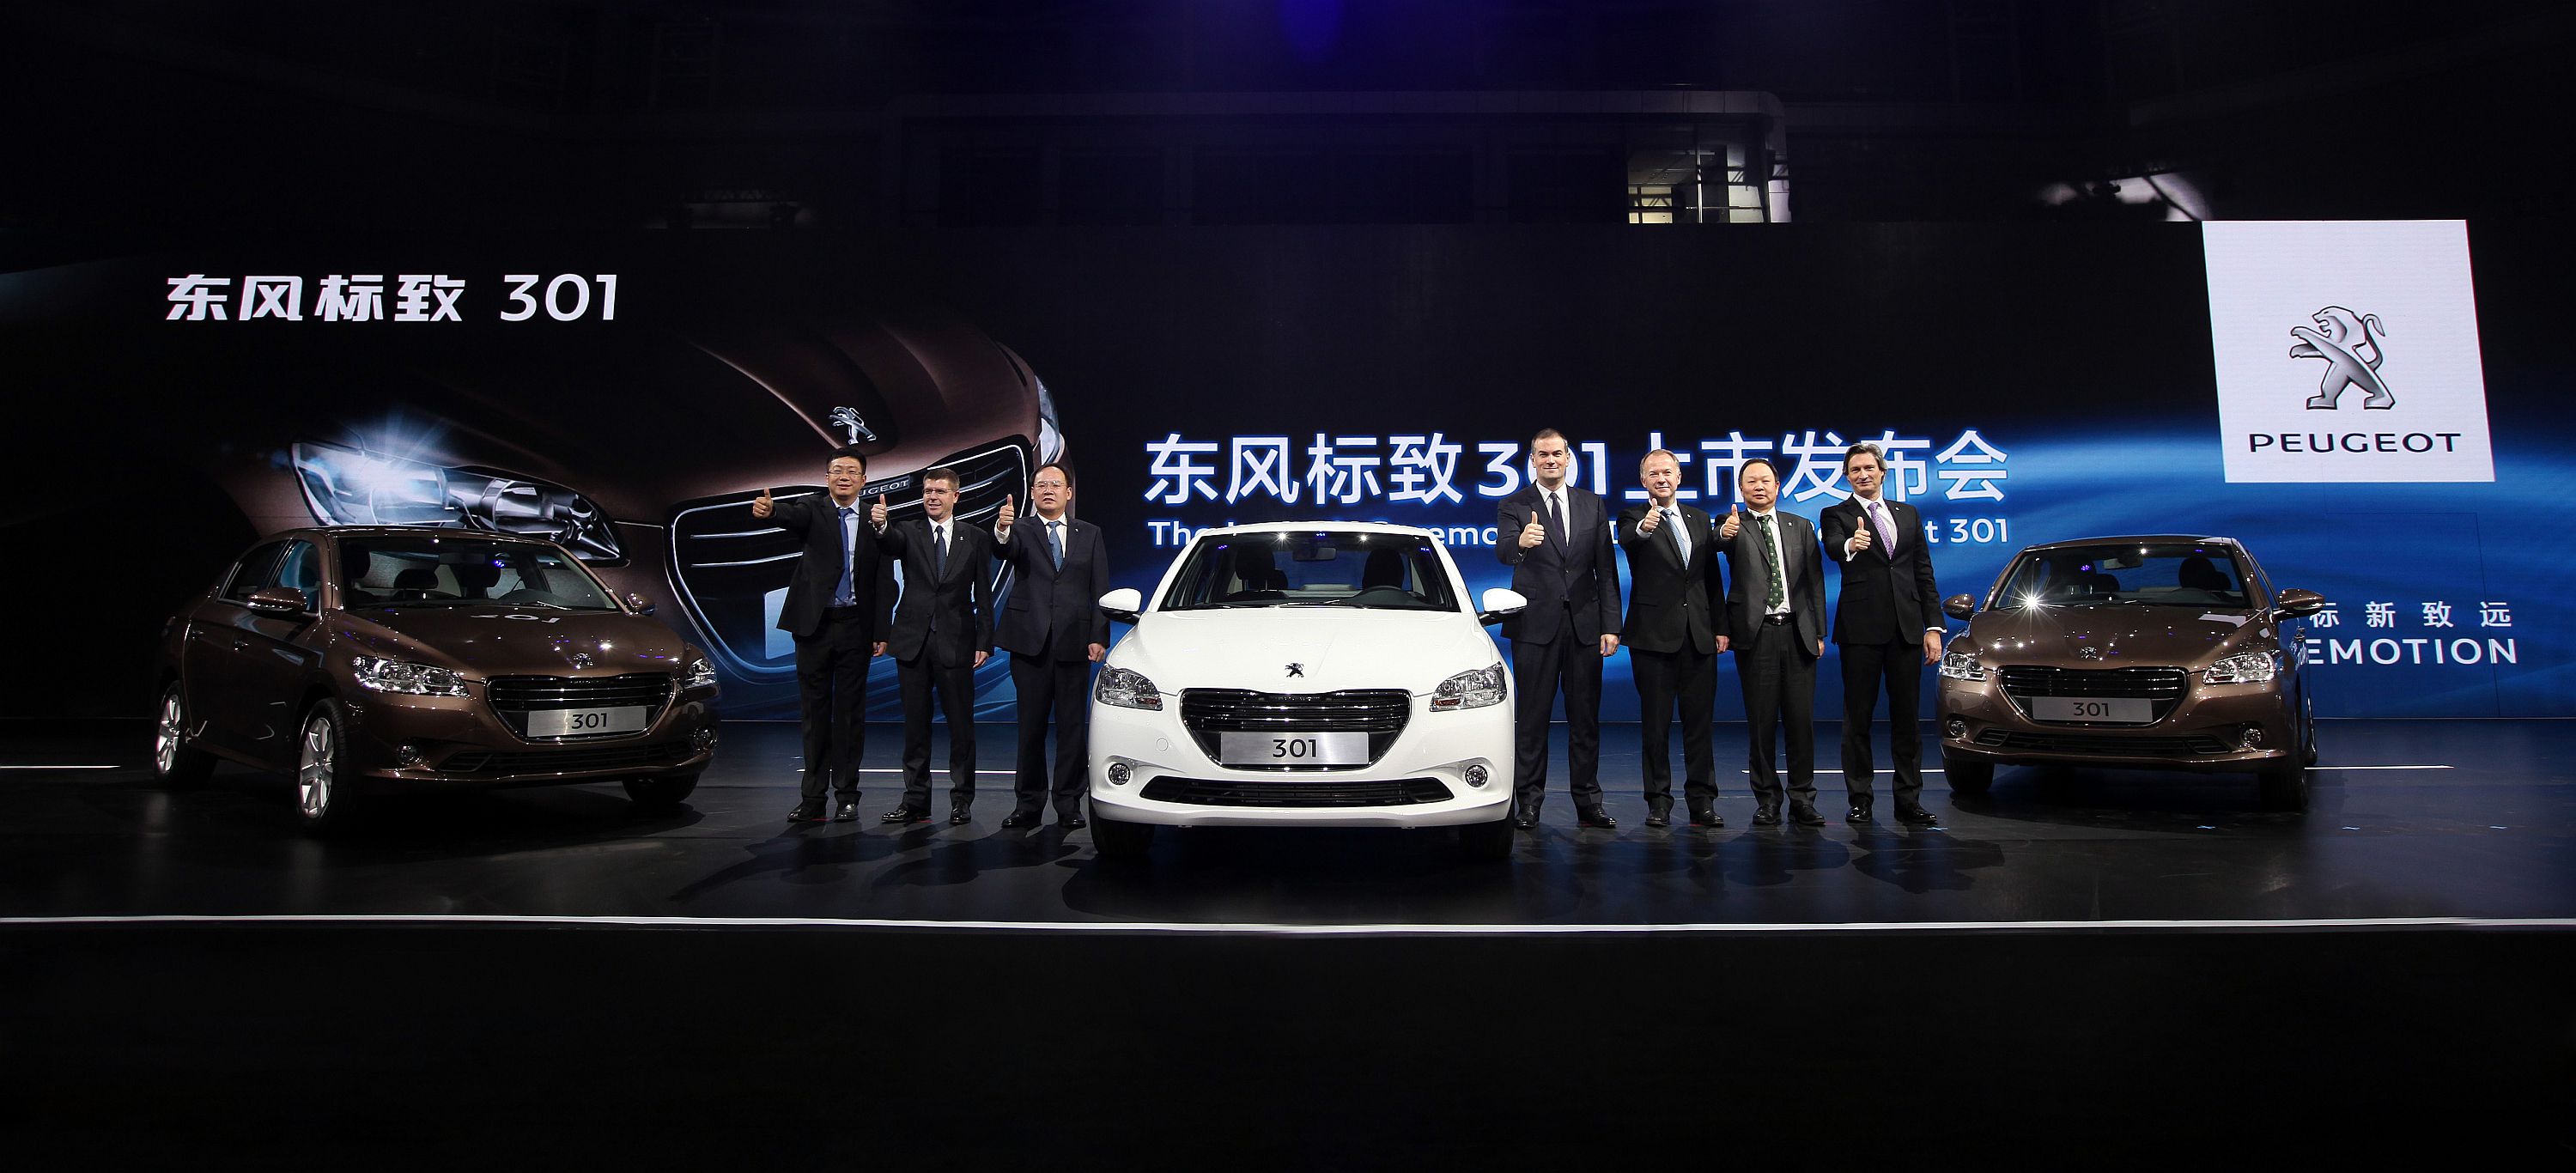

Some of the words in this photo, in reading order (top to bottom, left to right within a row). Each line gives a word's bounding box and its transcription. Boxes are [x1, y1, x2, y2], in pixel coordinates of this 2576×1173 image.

[166, 274, 465, 321] 东风标致
[500, 273, 617, 321] 301
[2249, 432, 2462, 453] PEUGEOT
[859, 479, 909, 496] UGEOT
[1950, 518, 2008, 543] 301
[2309, 600, 2512, 628] 标新致远
[2306, 638, 2517, 665] EMOTION
[2073, 702, 2110, 717] 301
[571, 712, 608, 730] 301
[1273, 738, 1316, 758] 301
